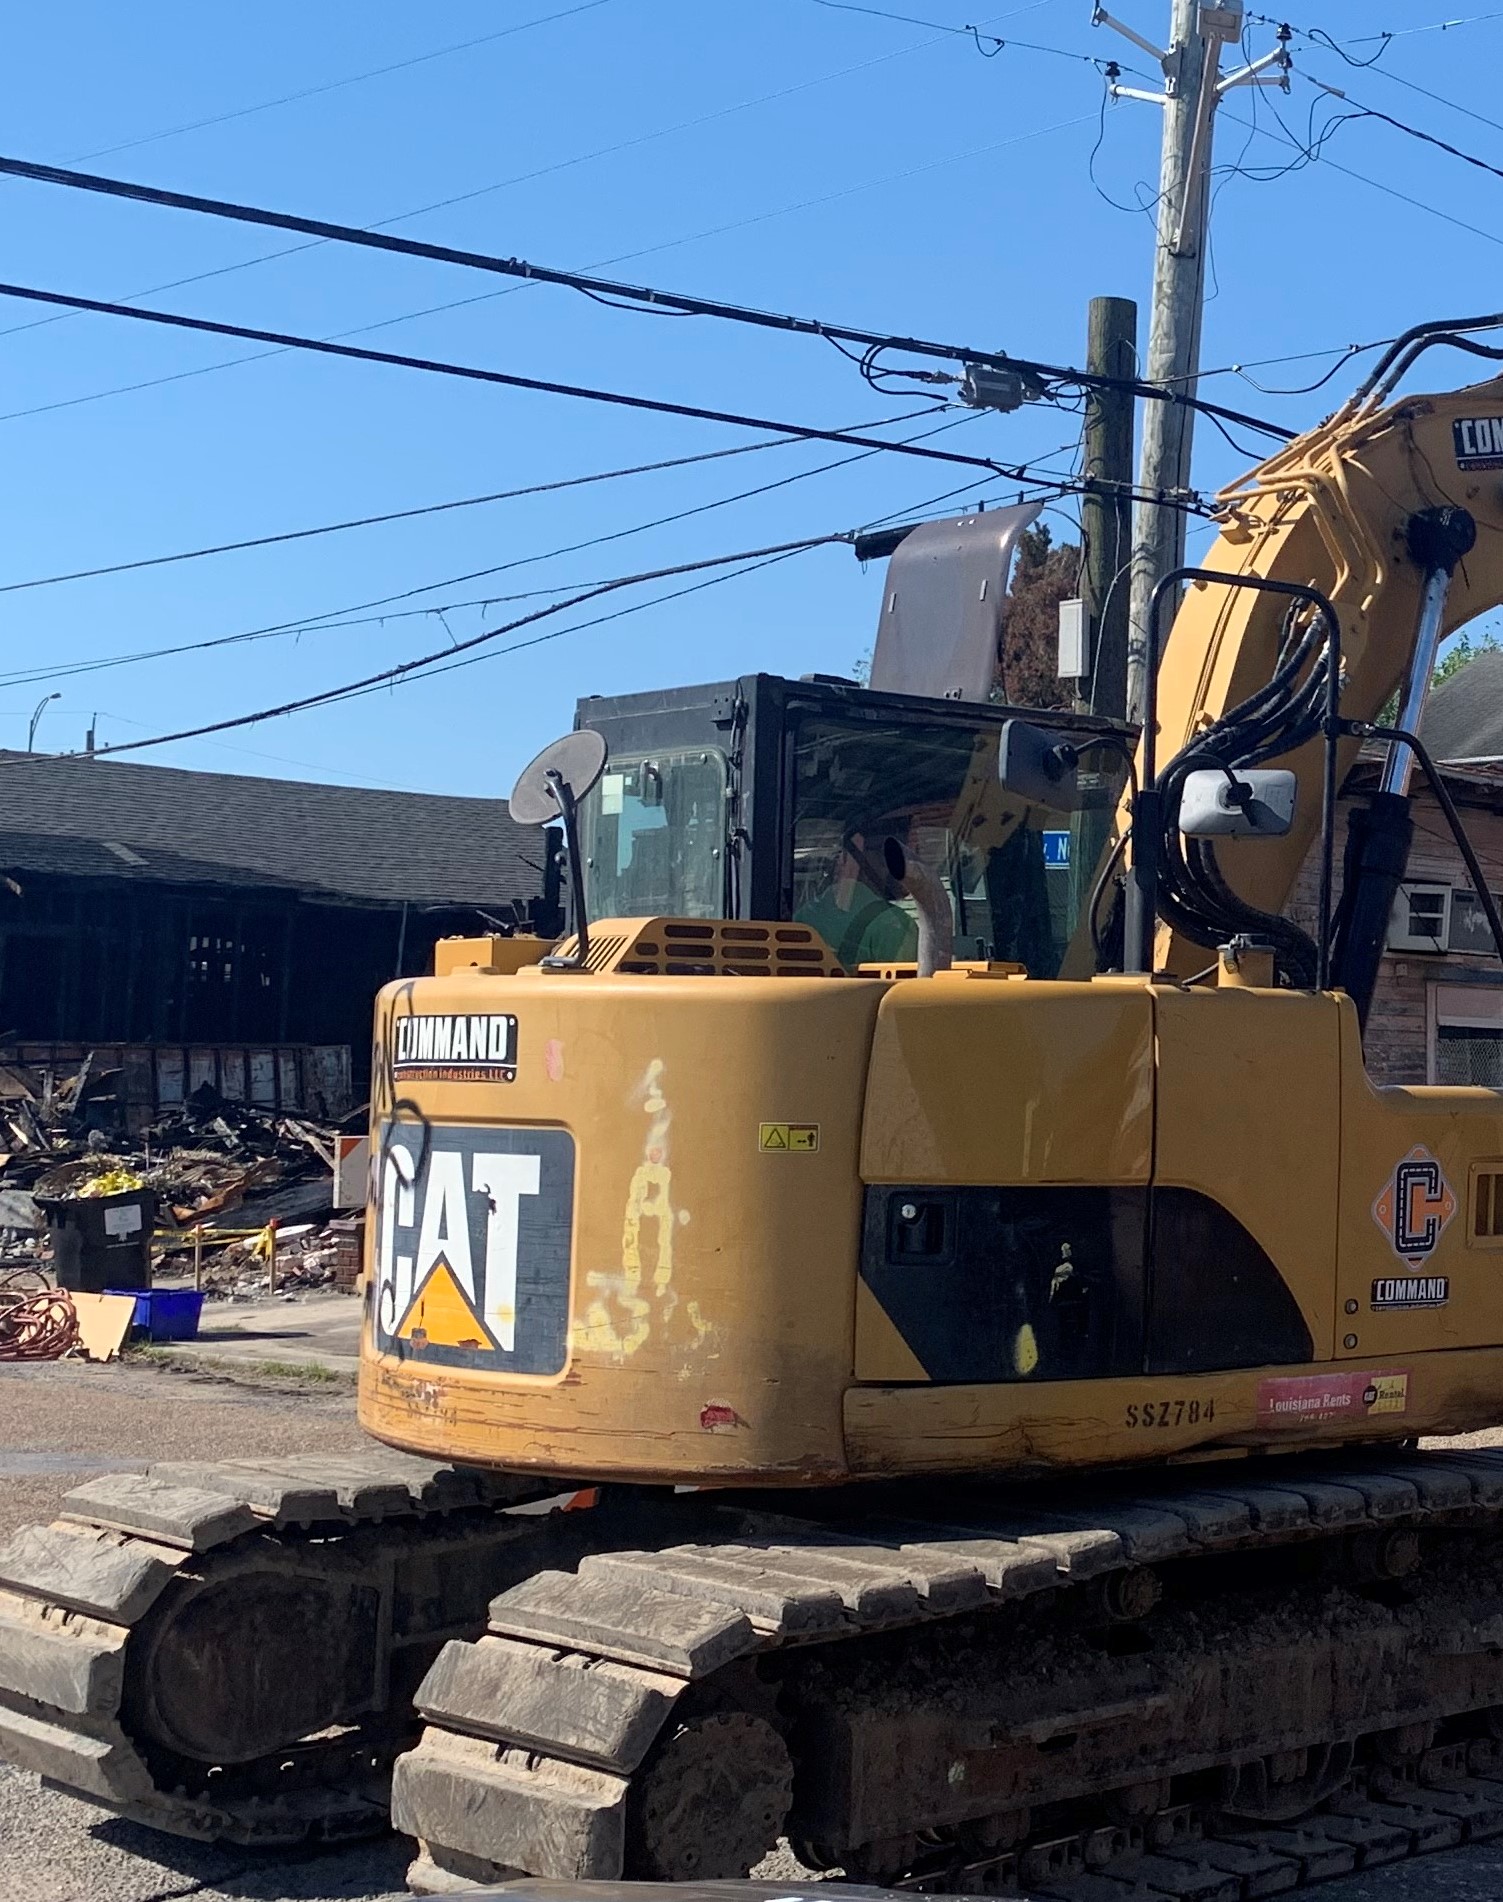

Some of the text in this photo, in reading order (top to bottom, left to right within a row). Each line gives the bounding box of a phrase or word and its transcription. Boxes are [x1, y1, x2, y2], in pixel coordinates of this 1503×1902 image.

[398, 1016, 507, 1060] COMMAND
[379, 1144, 541, 1352] CAT
[1376, 1278, 1445, 1301] COMMAND
[1126, 1398, 1214, 1428] SSZ784
[1270, 1395, 1320, 1413] Louisiana
[1322, 1393, 1352, 1408] Rents
